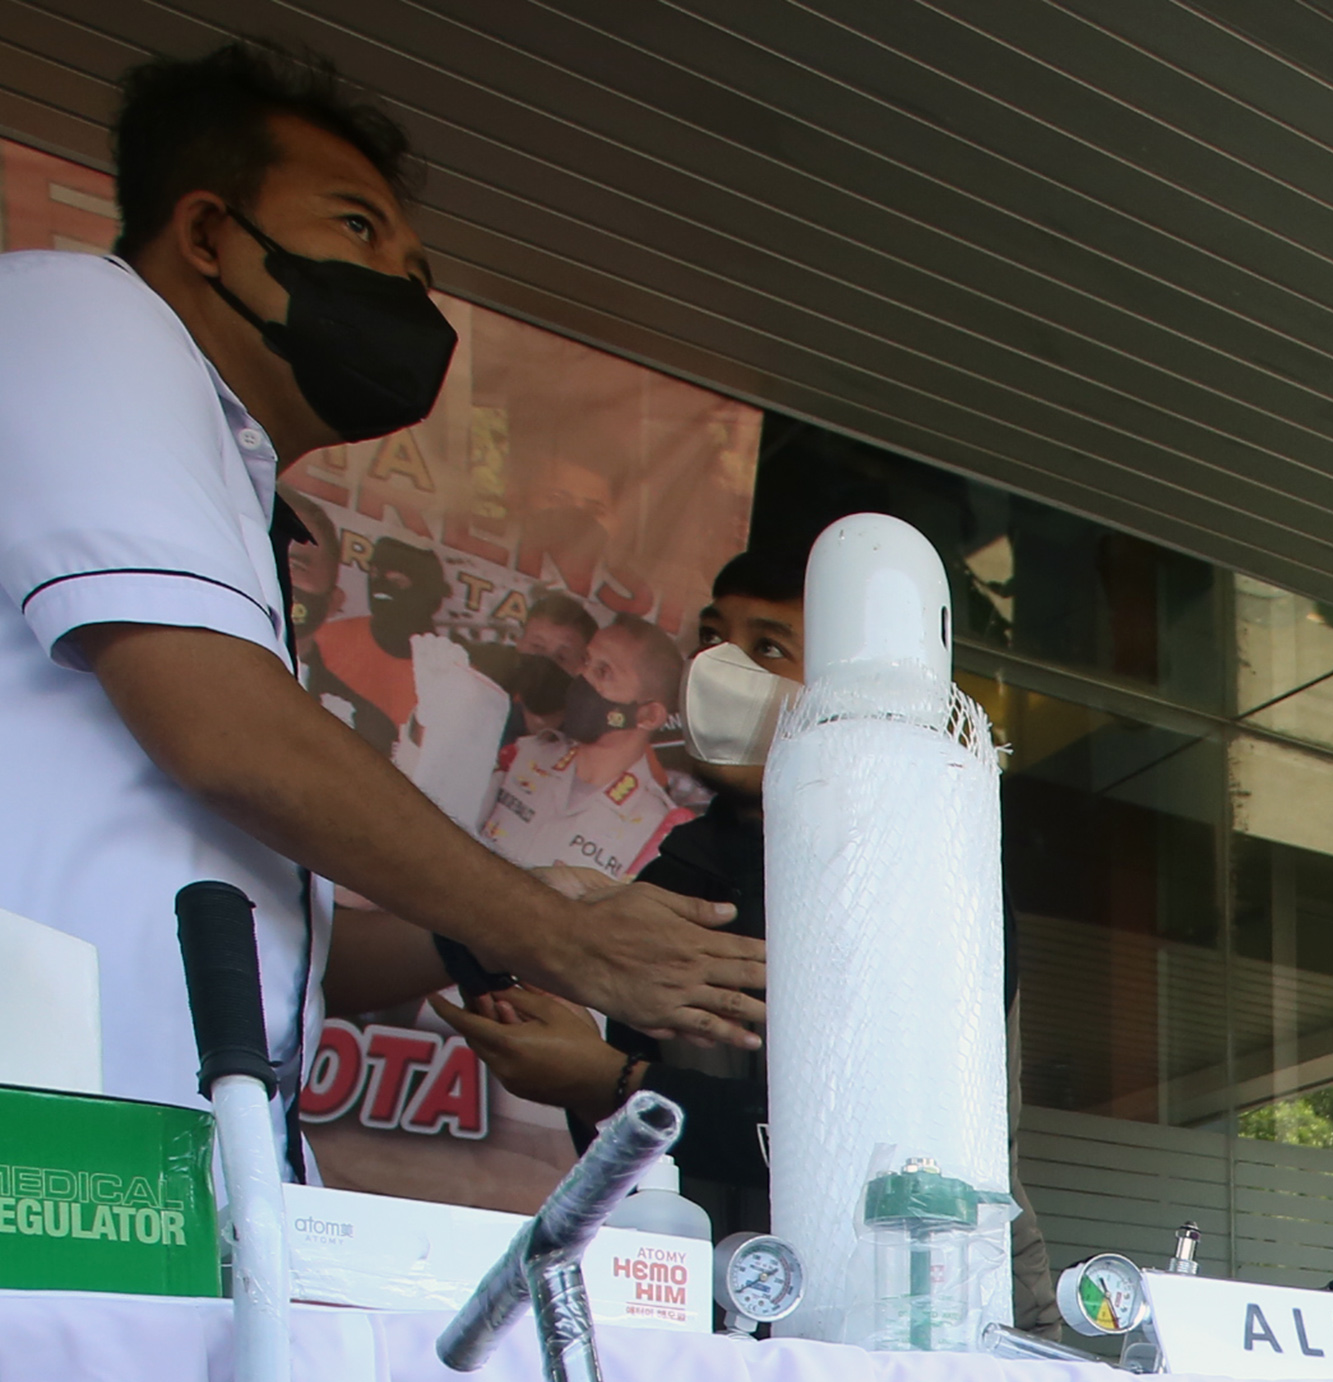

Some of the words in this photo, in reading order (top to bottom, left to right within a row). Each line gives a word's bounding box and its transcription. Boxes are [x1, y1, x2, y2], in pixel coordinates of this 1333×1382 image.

[569, 834, 622, 877] POLRI
[637, 1247, 688, 1264] ATOMY
[613, 1256, 688, 1286] HEMO
[635, 1282, 687, 1306] HIM
